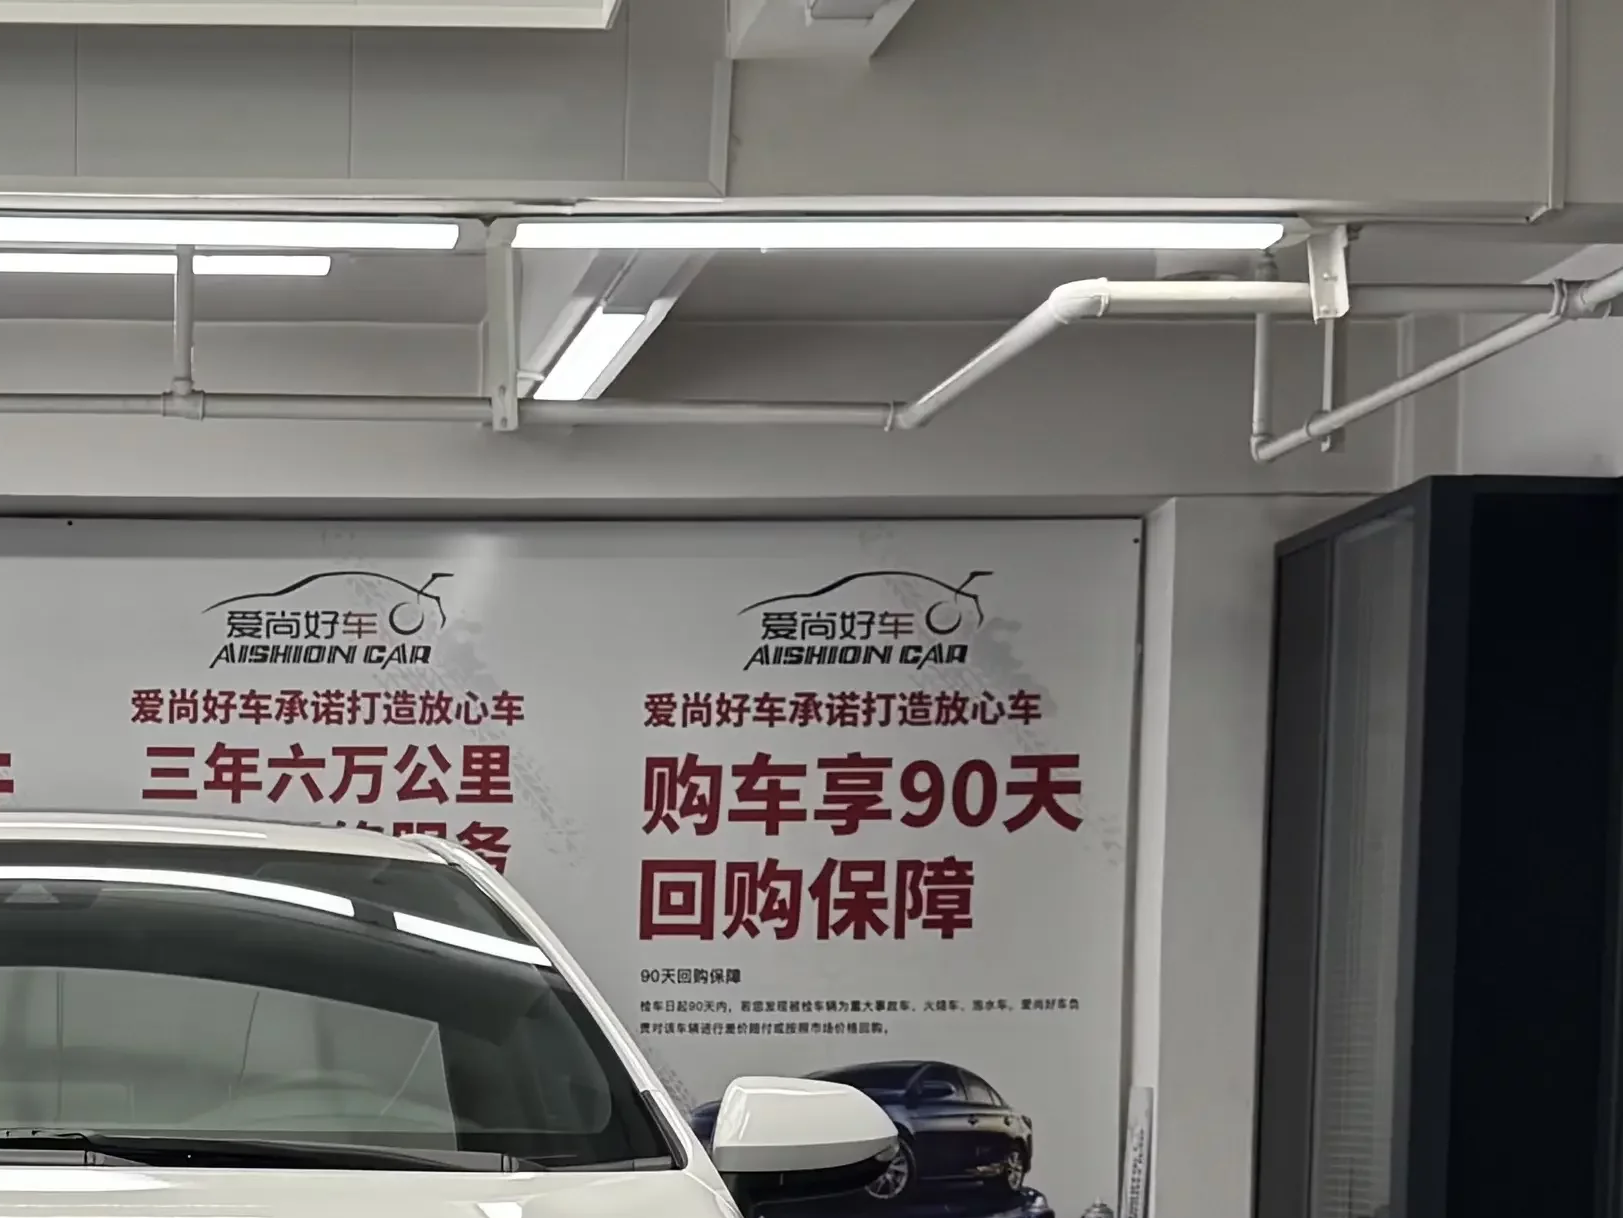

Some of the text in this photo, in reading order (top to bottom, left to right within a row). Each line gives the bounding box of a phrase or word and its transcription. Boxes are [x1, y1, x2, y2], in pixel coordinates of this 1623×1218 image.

[226, 610, 378, 640] 爱尚好车
[761, 610, 915, 641] 爱尚好车
[362, 642, 432, 670] CAR
[898, 642, 969, 671] CAR
[130, 687, 525, 727] 爱尚好车承诺打造放心车
[643, 687, 1043, 729] 爱尚好车承诺打造放心车
[141, 741, 514, 805] 三年六万公里
[641, 751, 1084, 837] 购车享90天
[639, 855, 975, 941] 回购保障
[640, 968, 742, 985] 90天回购保障
